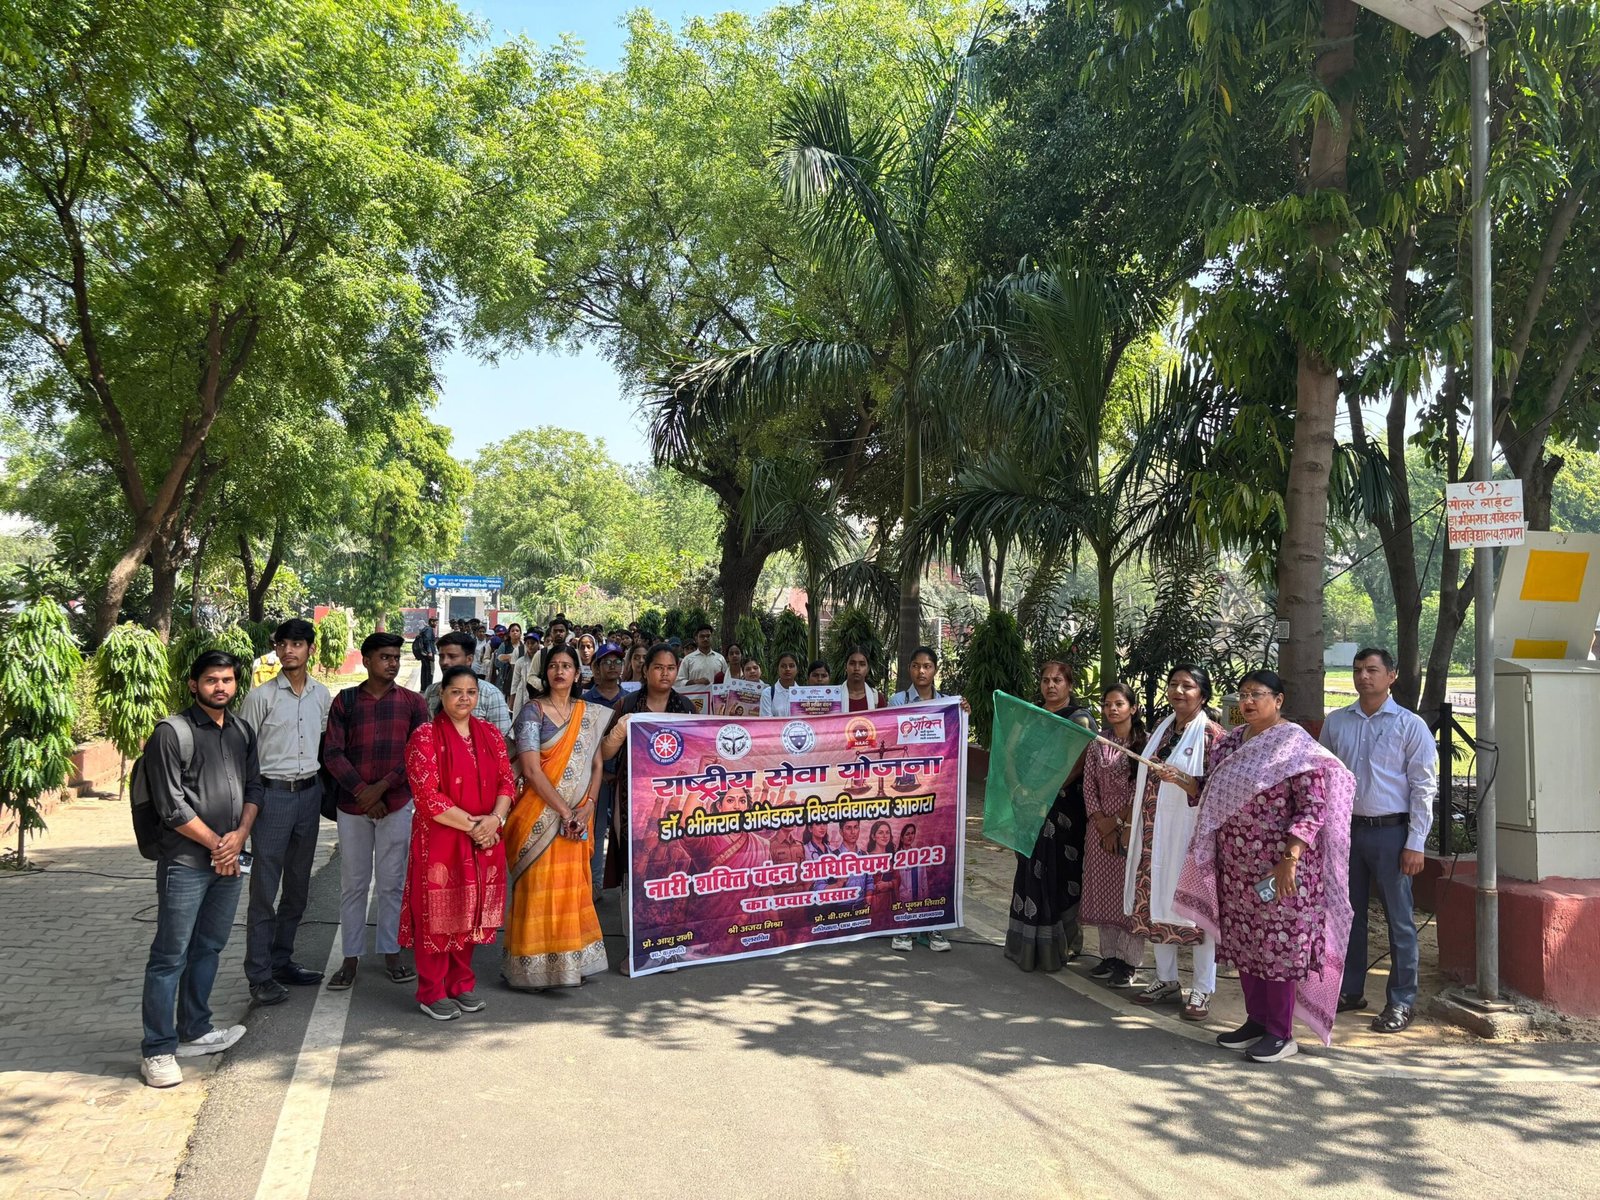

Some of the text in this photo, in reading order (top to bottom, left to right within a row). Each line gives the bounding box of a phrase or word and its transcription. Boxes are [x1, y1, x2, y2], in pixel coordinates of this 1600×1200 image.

[1469, 481, 1494, 496] (4)
[1448, 496, 1475, 511] सोलर
[855, 729, 868, 737] A+
[652, 755, 944, 802] राष्ट्रीय सेवा योजना
[660, 793, 934, 841] डॉ. भीमराव आंबेडकर विश्वविद्यालय आगरा
[646, 847, 945, 901] नारी शक्ति वंदन अधिनियम 2023
[744, 887, 858, 913] का प्रचार प्रसार
[728, 924, 738, 935] श्री
[740, 921, 761, 933] अजय
[642, 938, 654, 949] प्रो.
[656, 936, 675, 947] आशु
